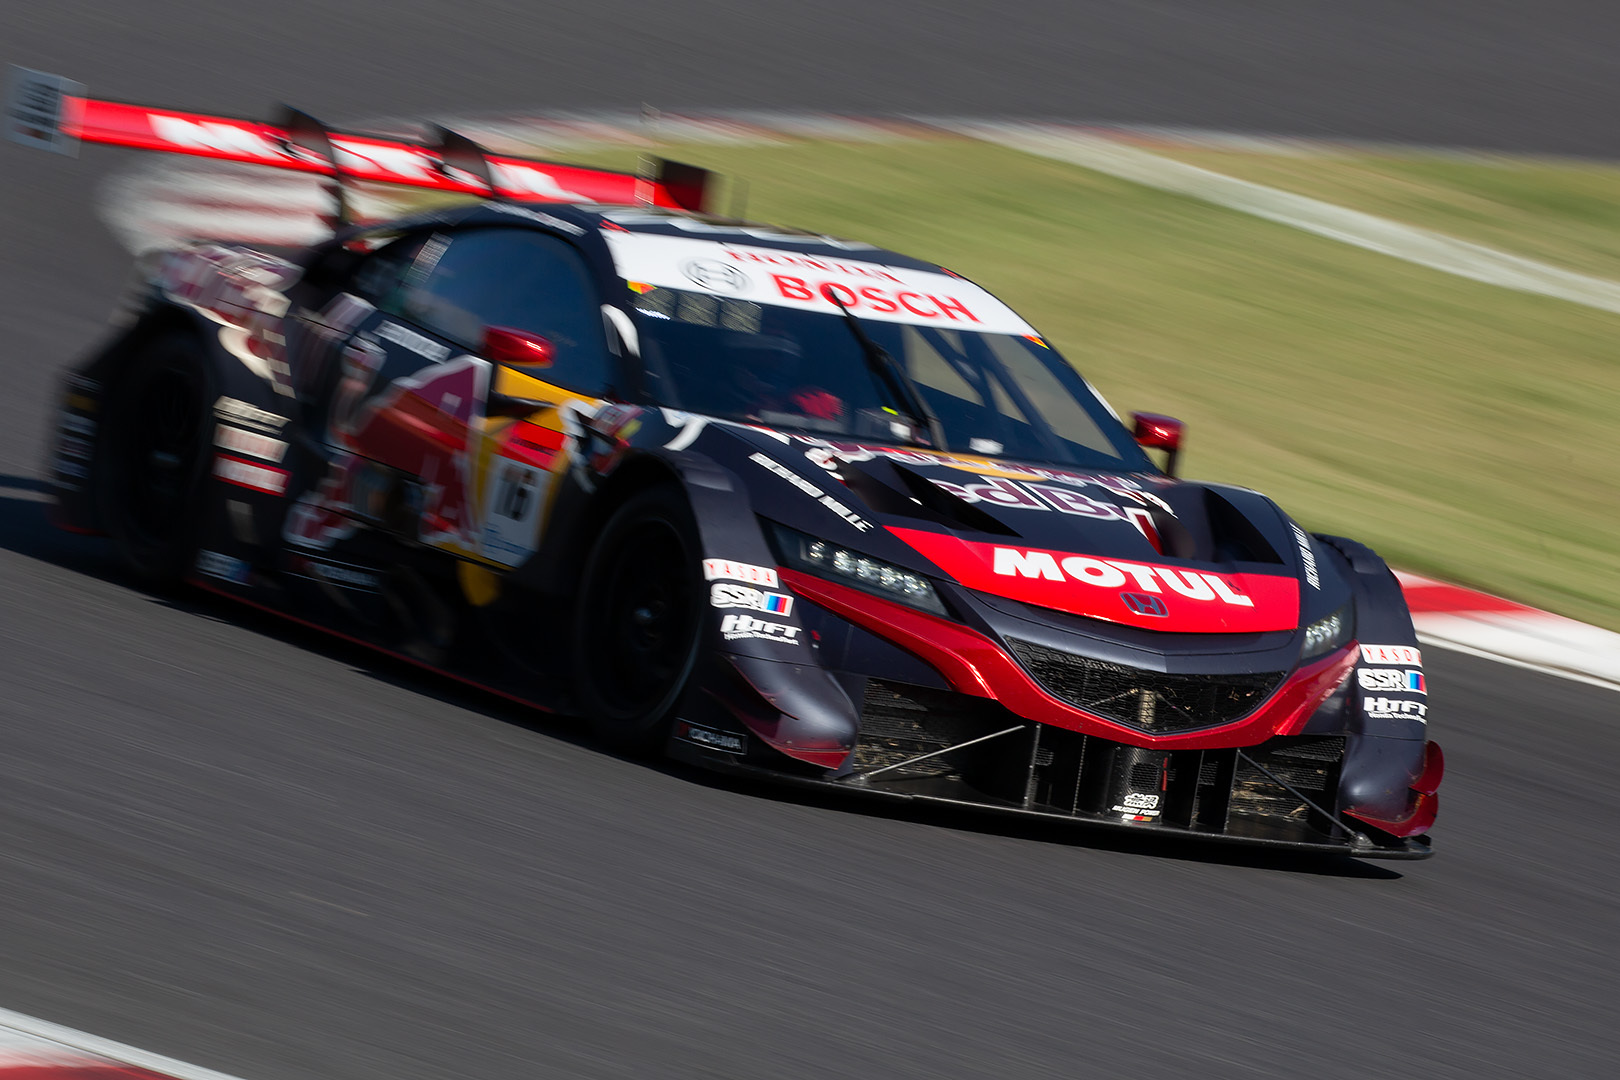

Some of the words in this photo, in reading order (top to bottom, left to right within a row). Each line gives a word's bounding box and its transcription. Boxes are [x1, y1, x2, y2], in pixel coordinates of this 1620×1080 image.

[769, 272, 984, 324] BOSCH
[705, 561, 775, 584] YASDA
[993, 547, 1255, 608] MOTUL
[1358, 668, 1407, 692] SSR
